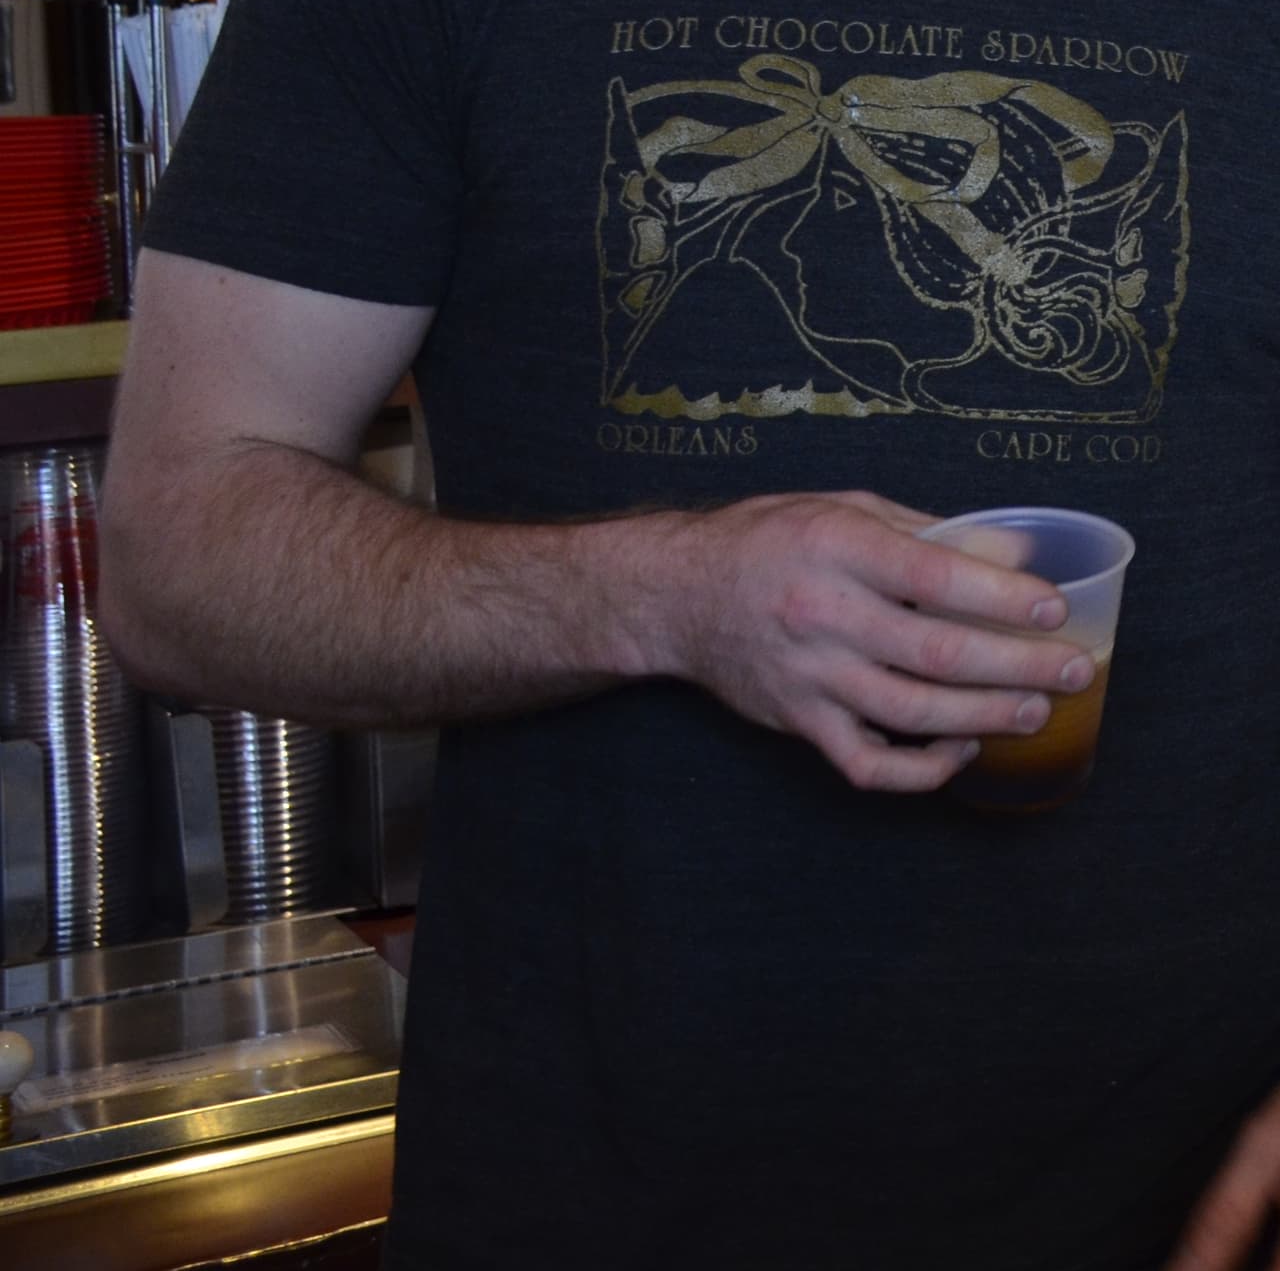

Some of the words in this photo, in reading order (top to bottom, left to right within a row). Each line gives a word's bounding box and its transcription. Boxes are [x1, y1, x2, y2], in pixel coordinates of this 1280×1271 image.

[610, 16, 698, 55] HOT
[715, 14, 963, 60] CHOCOLATE
[981, 30, 1190, 84] SPARROW
[598, 423, 760, 458] ORLEANS
[976, 430, 1072, 463] CAPE
[1085, 434, 1162, 463] COD
